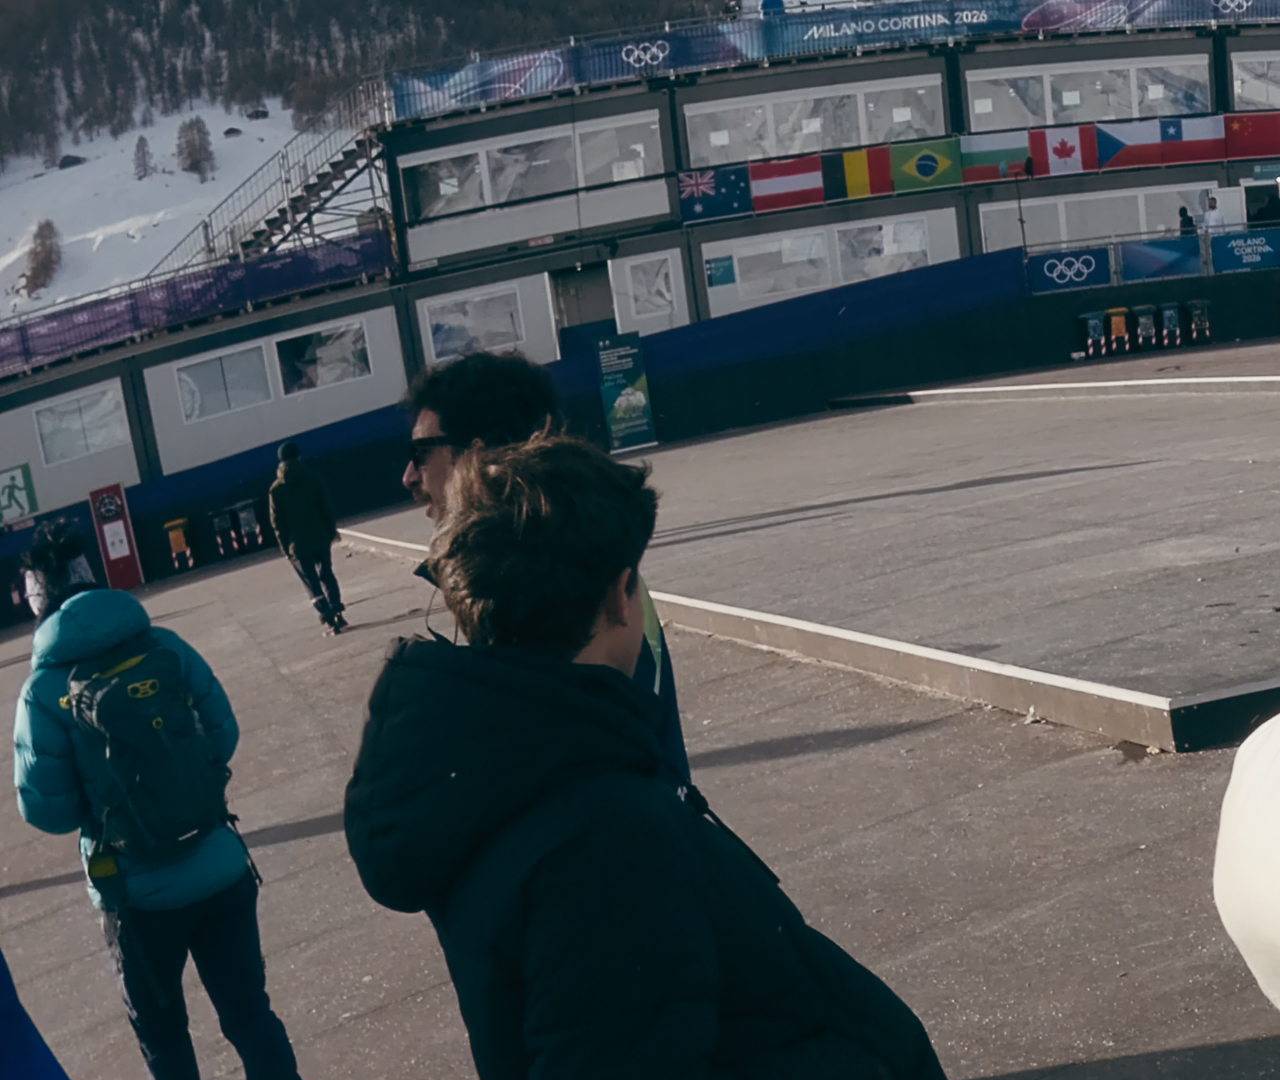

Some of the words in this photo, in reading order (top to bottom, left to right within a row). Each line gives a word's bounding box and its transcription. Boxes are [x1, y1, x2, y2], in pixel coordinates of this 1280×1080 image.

[803, 20, 875, 41] MILANO
[878, 13, 951, 32] CORTINA
[954, 9, 988, 25] 2026
[1227, 236, 1266, 249] MILANO
[1234, 244, 1275, 256] CORTINA
